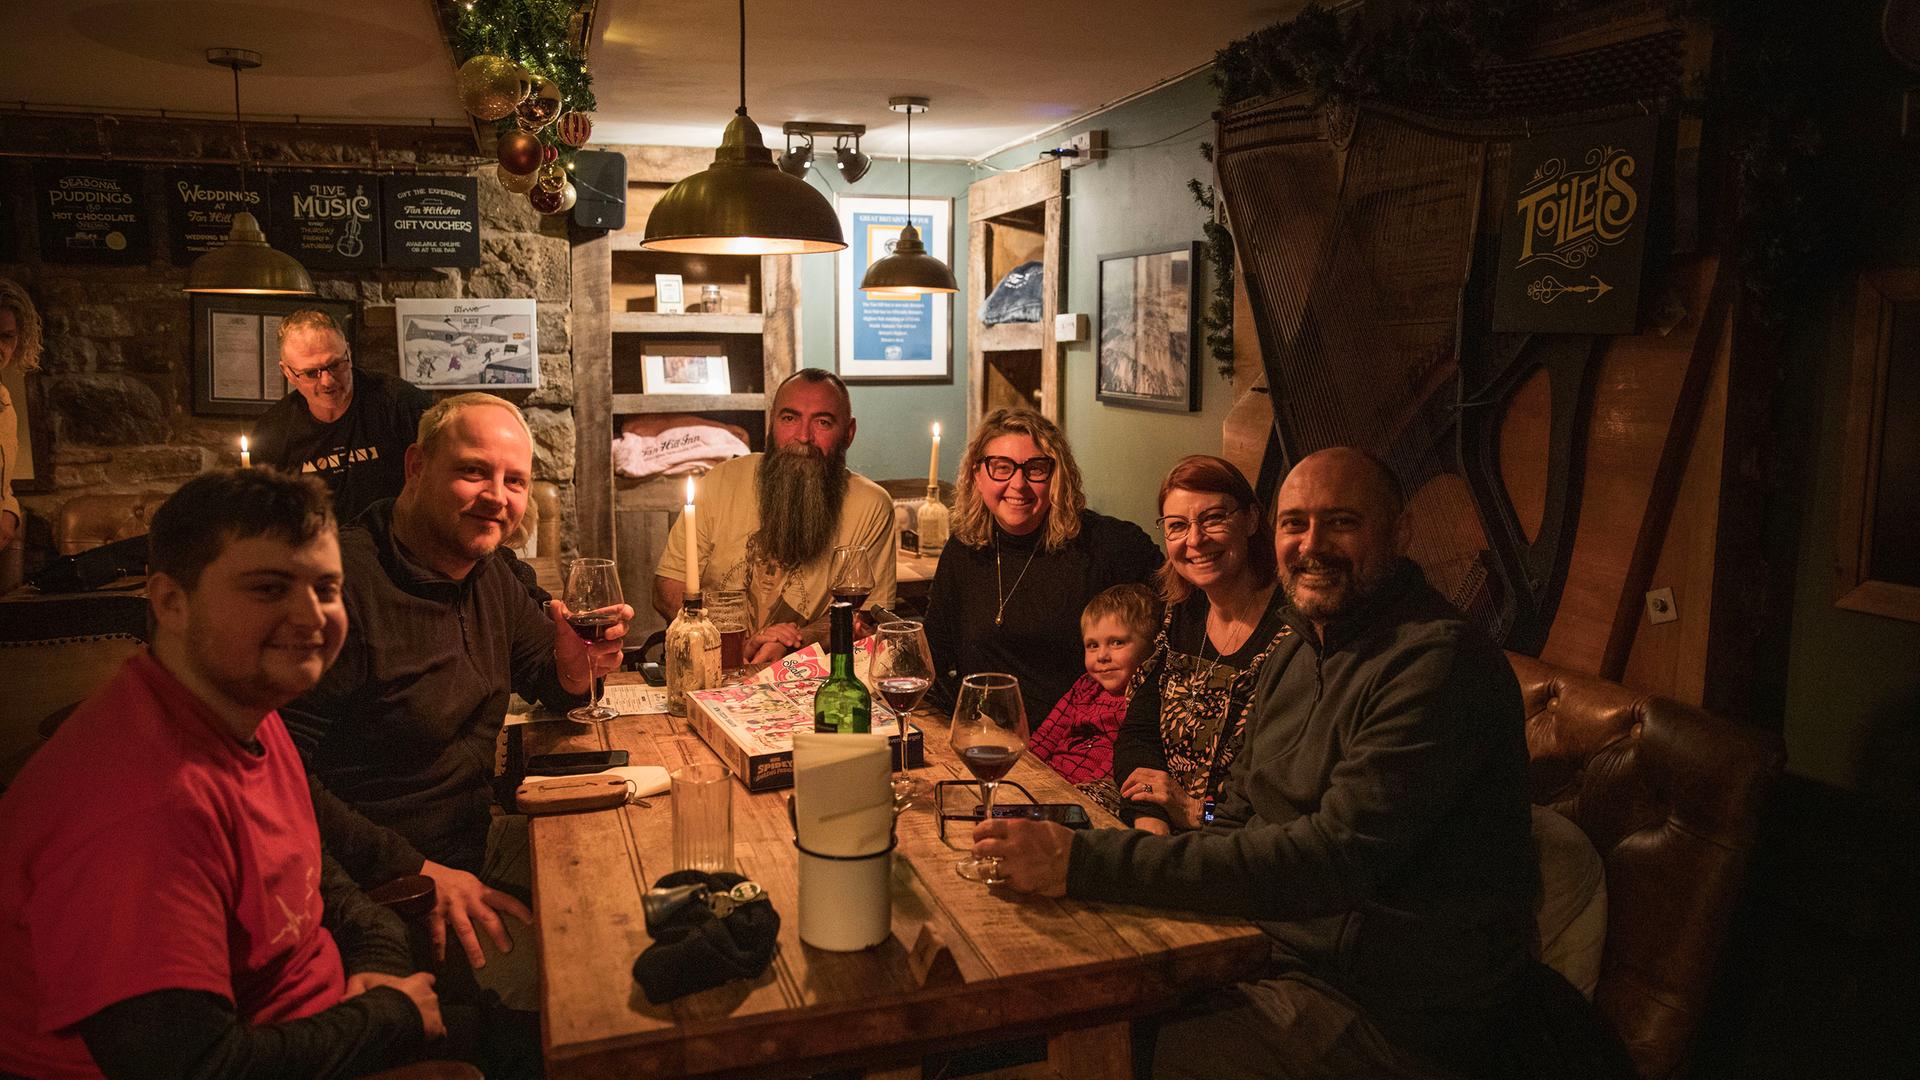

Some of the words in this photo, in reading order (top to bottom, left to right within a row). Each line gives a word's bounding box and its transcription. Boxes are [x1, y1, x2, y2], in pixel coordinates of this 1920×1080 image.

[59, 178, 120, 190] SEASONAL
[310, 184, 347, 199] LIVE
[49, 190, 133, 205] PUDDINGS
[177, 180, 261, 204] WEDDINGS
[397, 190, 411, 200] GIFT
[413, 188, 426, 196] THE
[428, 187, 467, 202] EXPERIENCE
[292, 193, 372, 220] MUSIC
[403, 205, 420, 215] Tan
[422, 205, 442, 215] Hill
[442, 206, 461, 216] Inn
[51, 211, 72, 221] HOT
[75, 212, 137, 223] CHOCOLATE
[394, 219, 418, 230] GIFT
[419, 220, 473, 233] VOUCHERS
